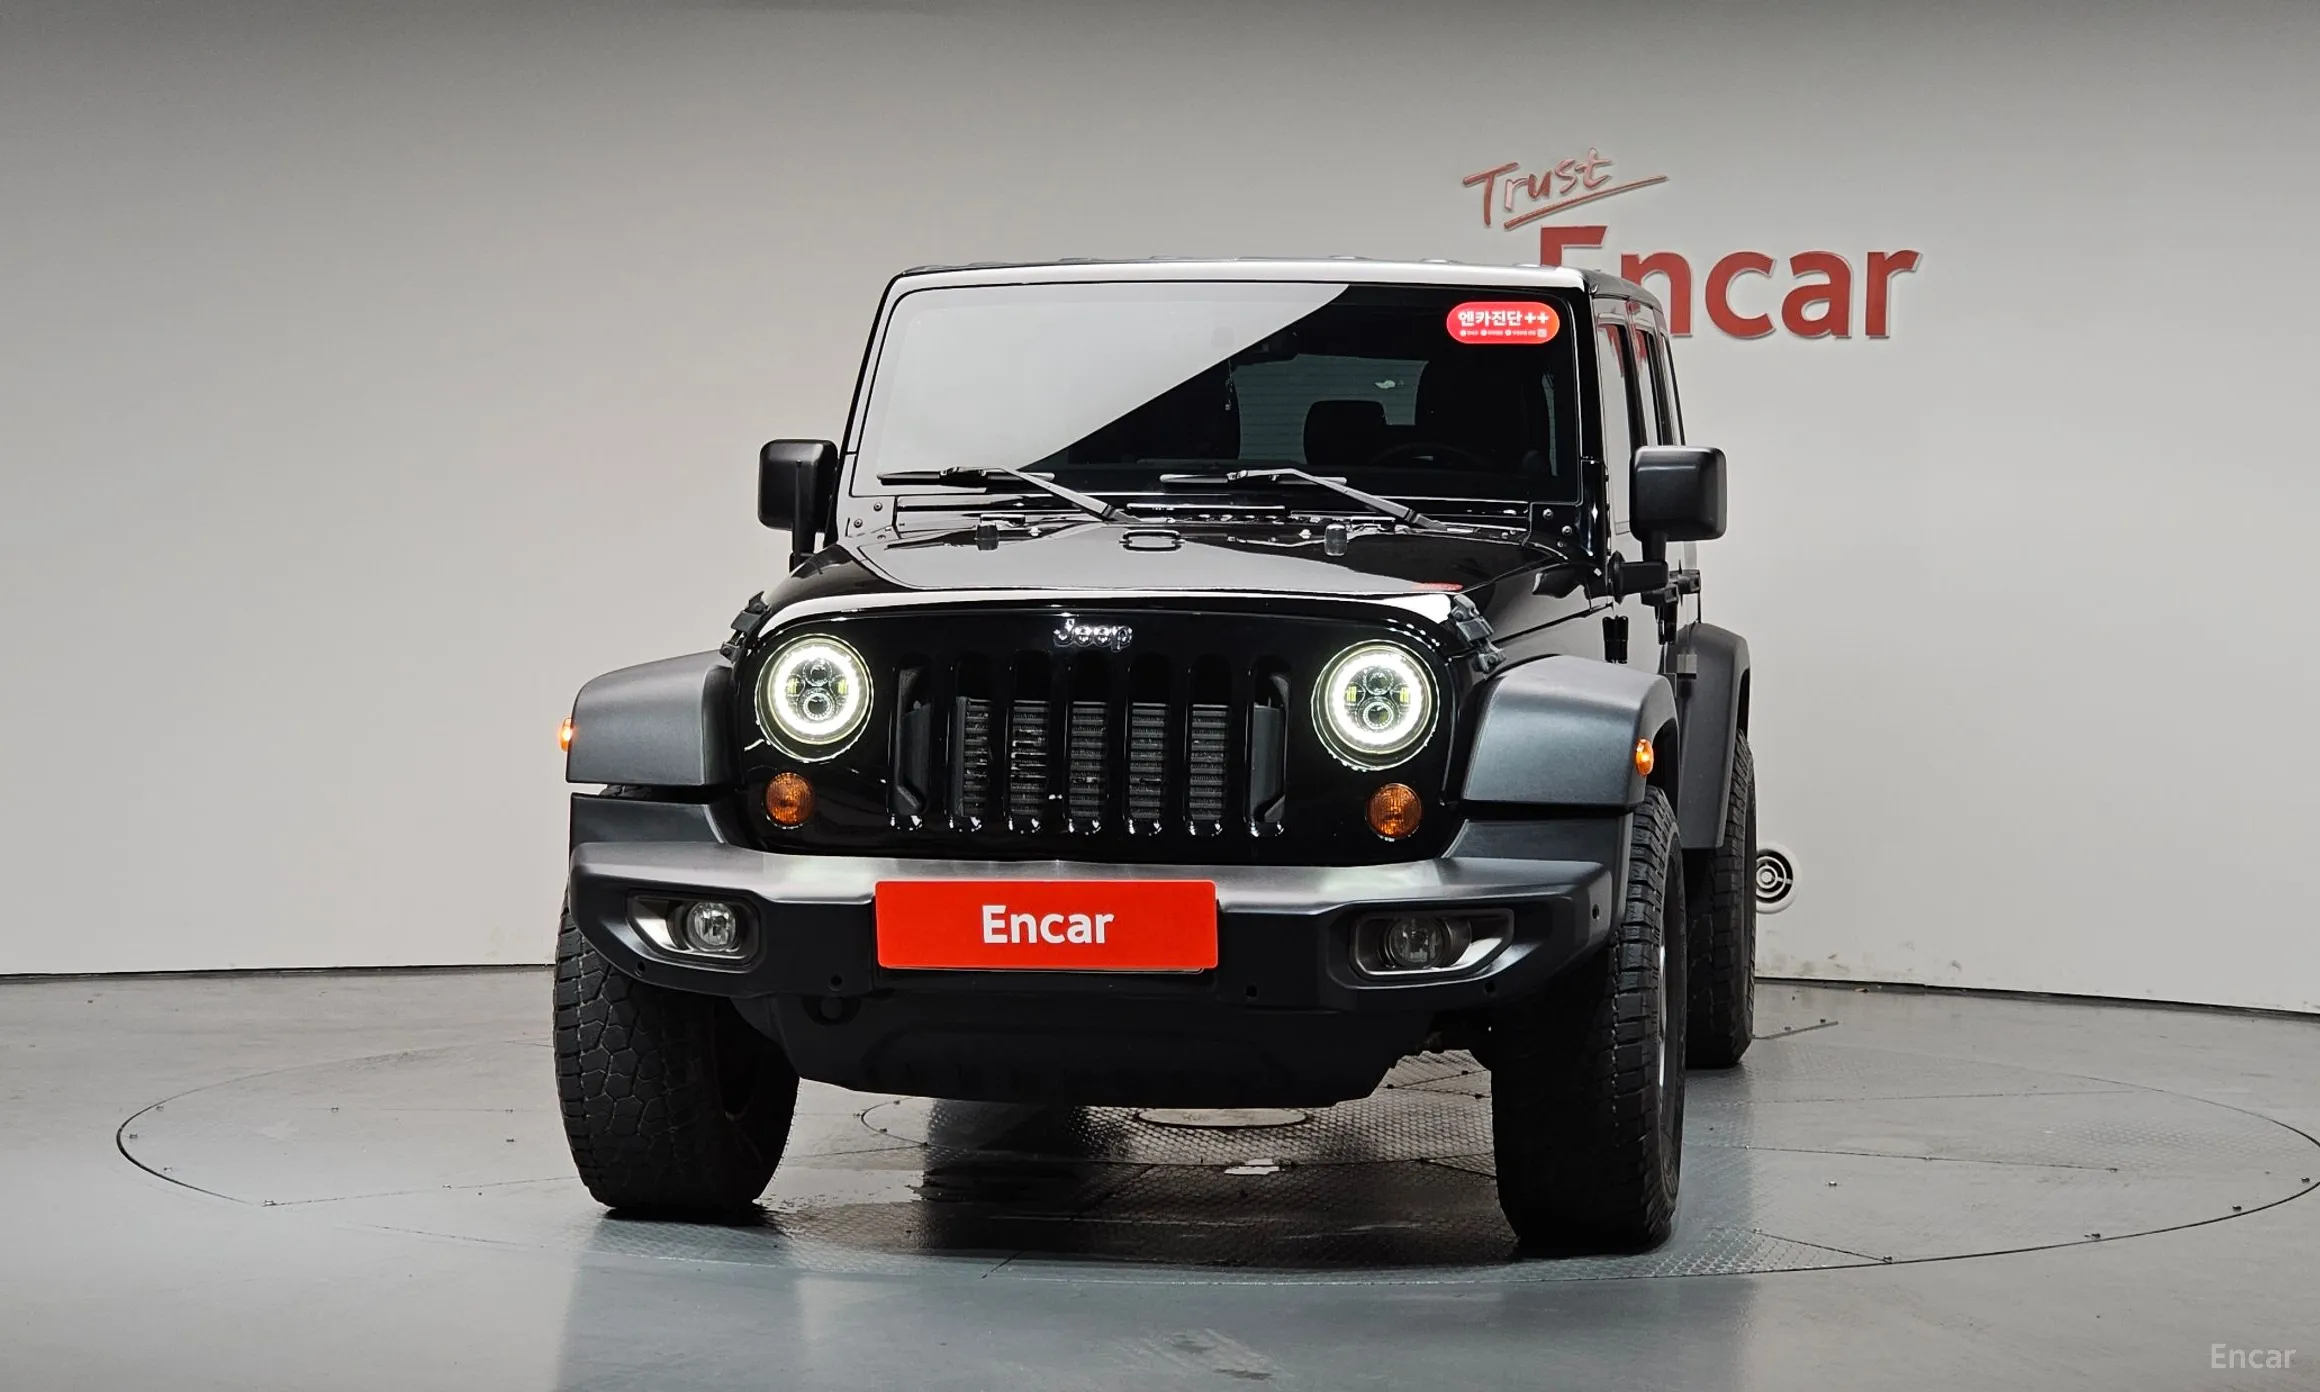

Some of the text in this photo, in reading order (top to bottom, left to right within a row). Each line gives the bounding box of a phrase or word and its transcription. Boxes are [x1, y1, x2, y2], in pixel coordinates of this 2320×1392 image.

[1462, 147, 1614, 226] Trust
[1053, 618, 1133, 652] Jeep
[982, 905, 1114, 944] Encar
